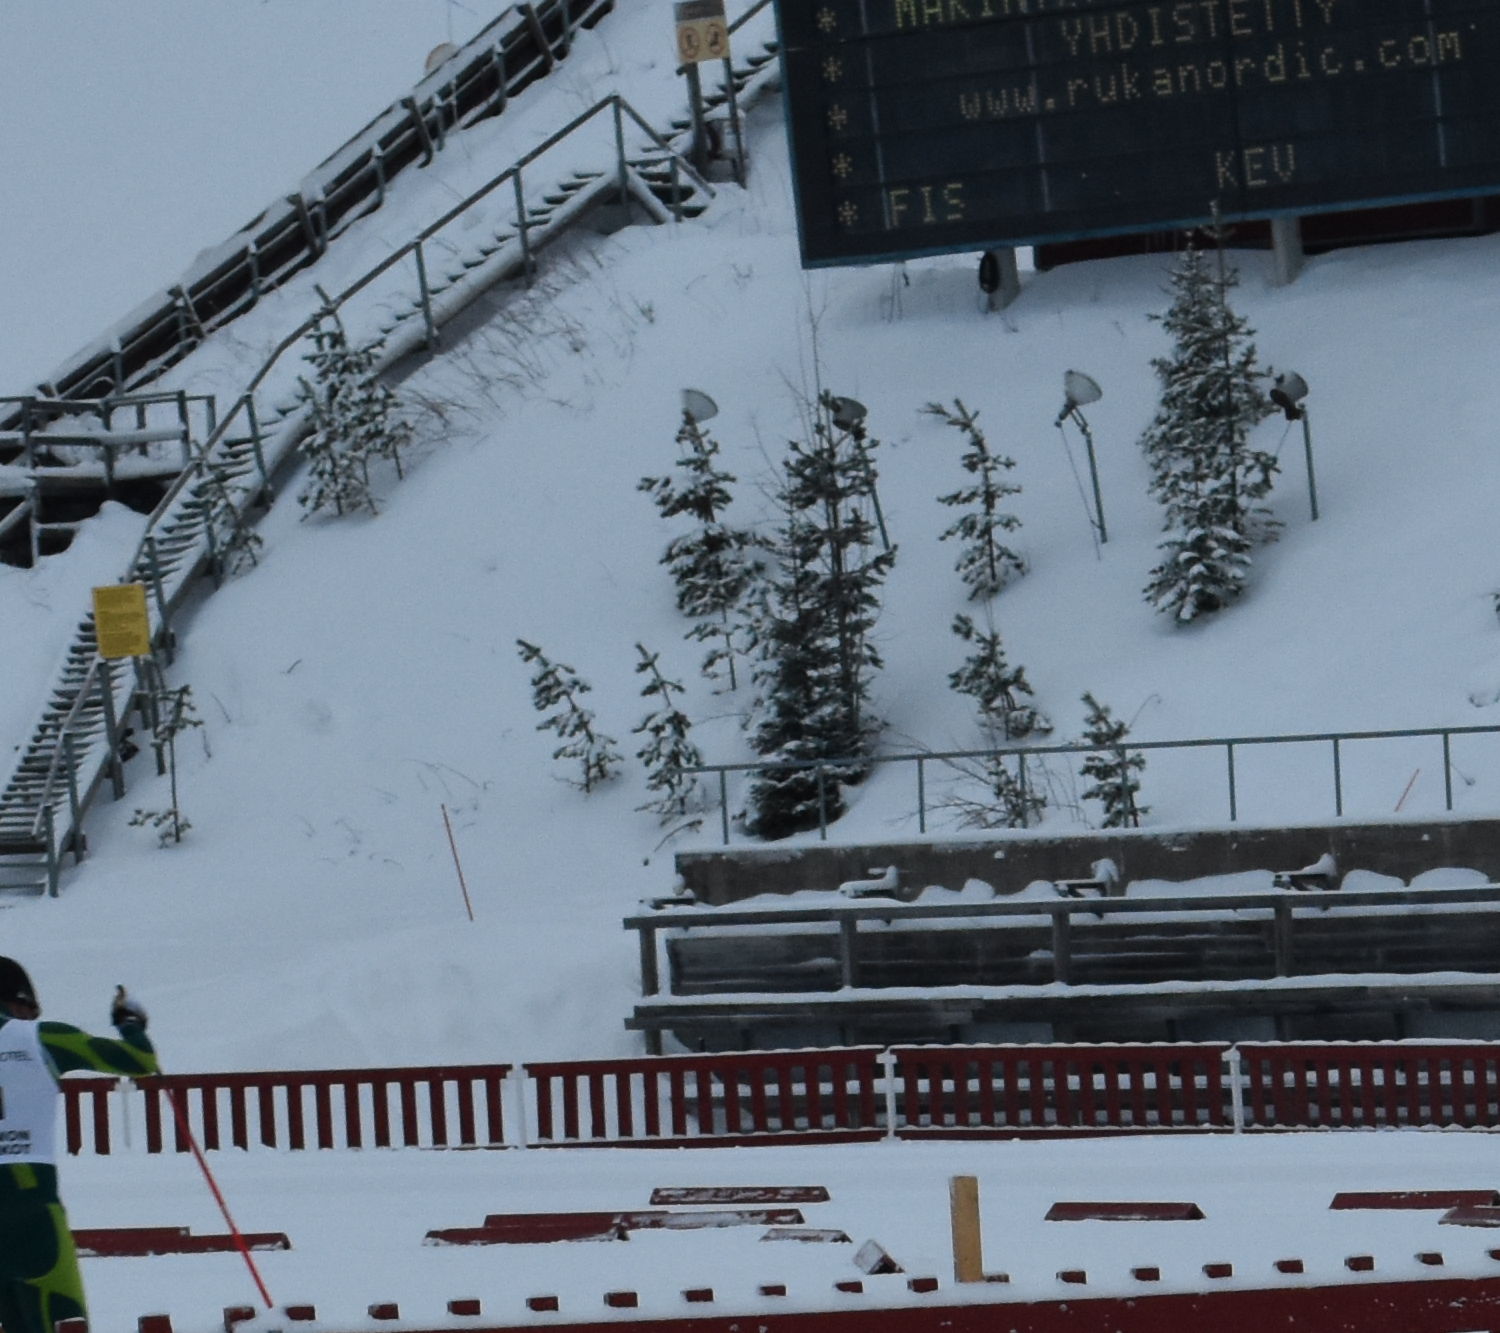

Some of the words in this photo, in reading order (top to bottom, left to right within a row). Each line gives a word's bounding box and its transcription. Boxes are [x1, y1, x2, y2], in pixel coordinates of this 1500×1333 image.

[959, 33, 1460, 119] www.rukanordic.com
[889, 183, 965, 227] FIS
[1216, 144, 1296, 190] KEV
